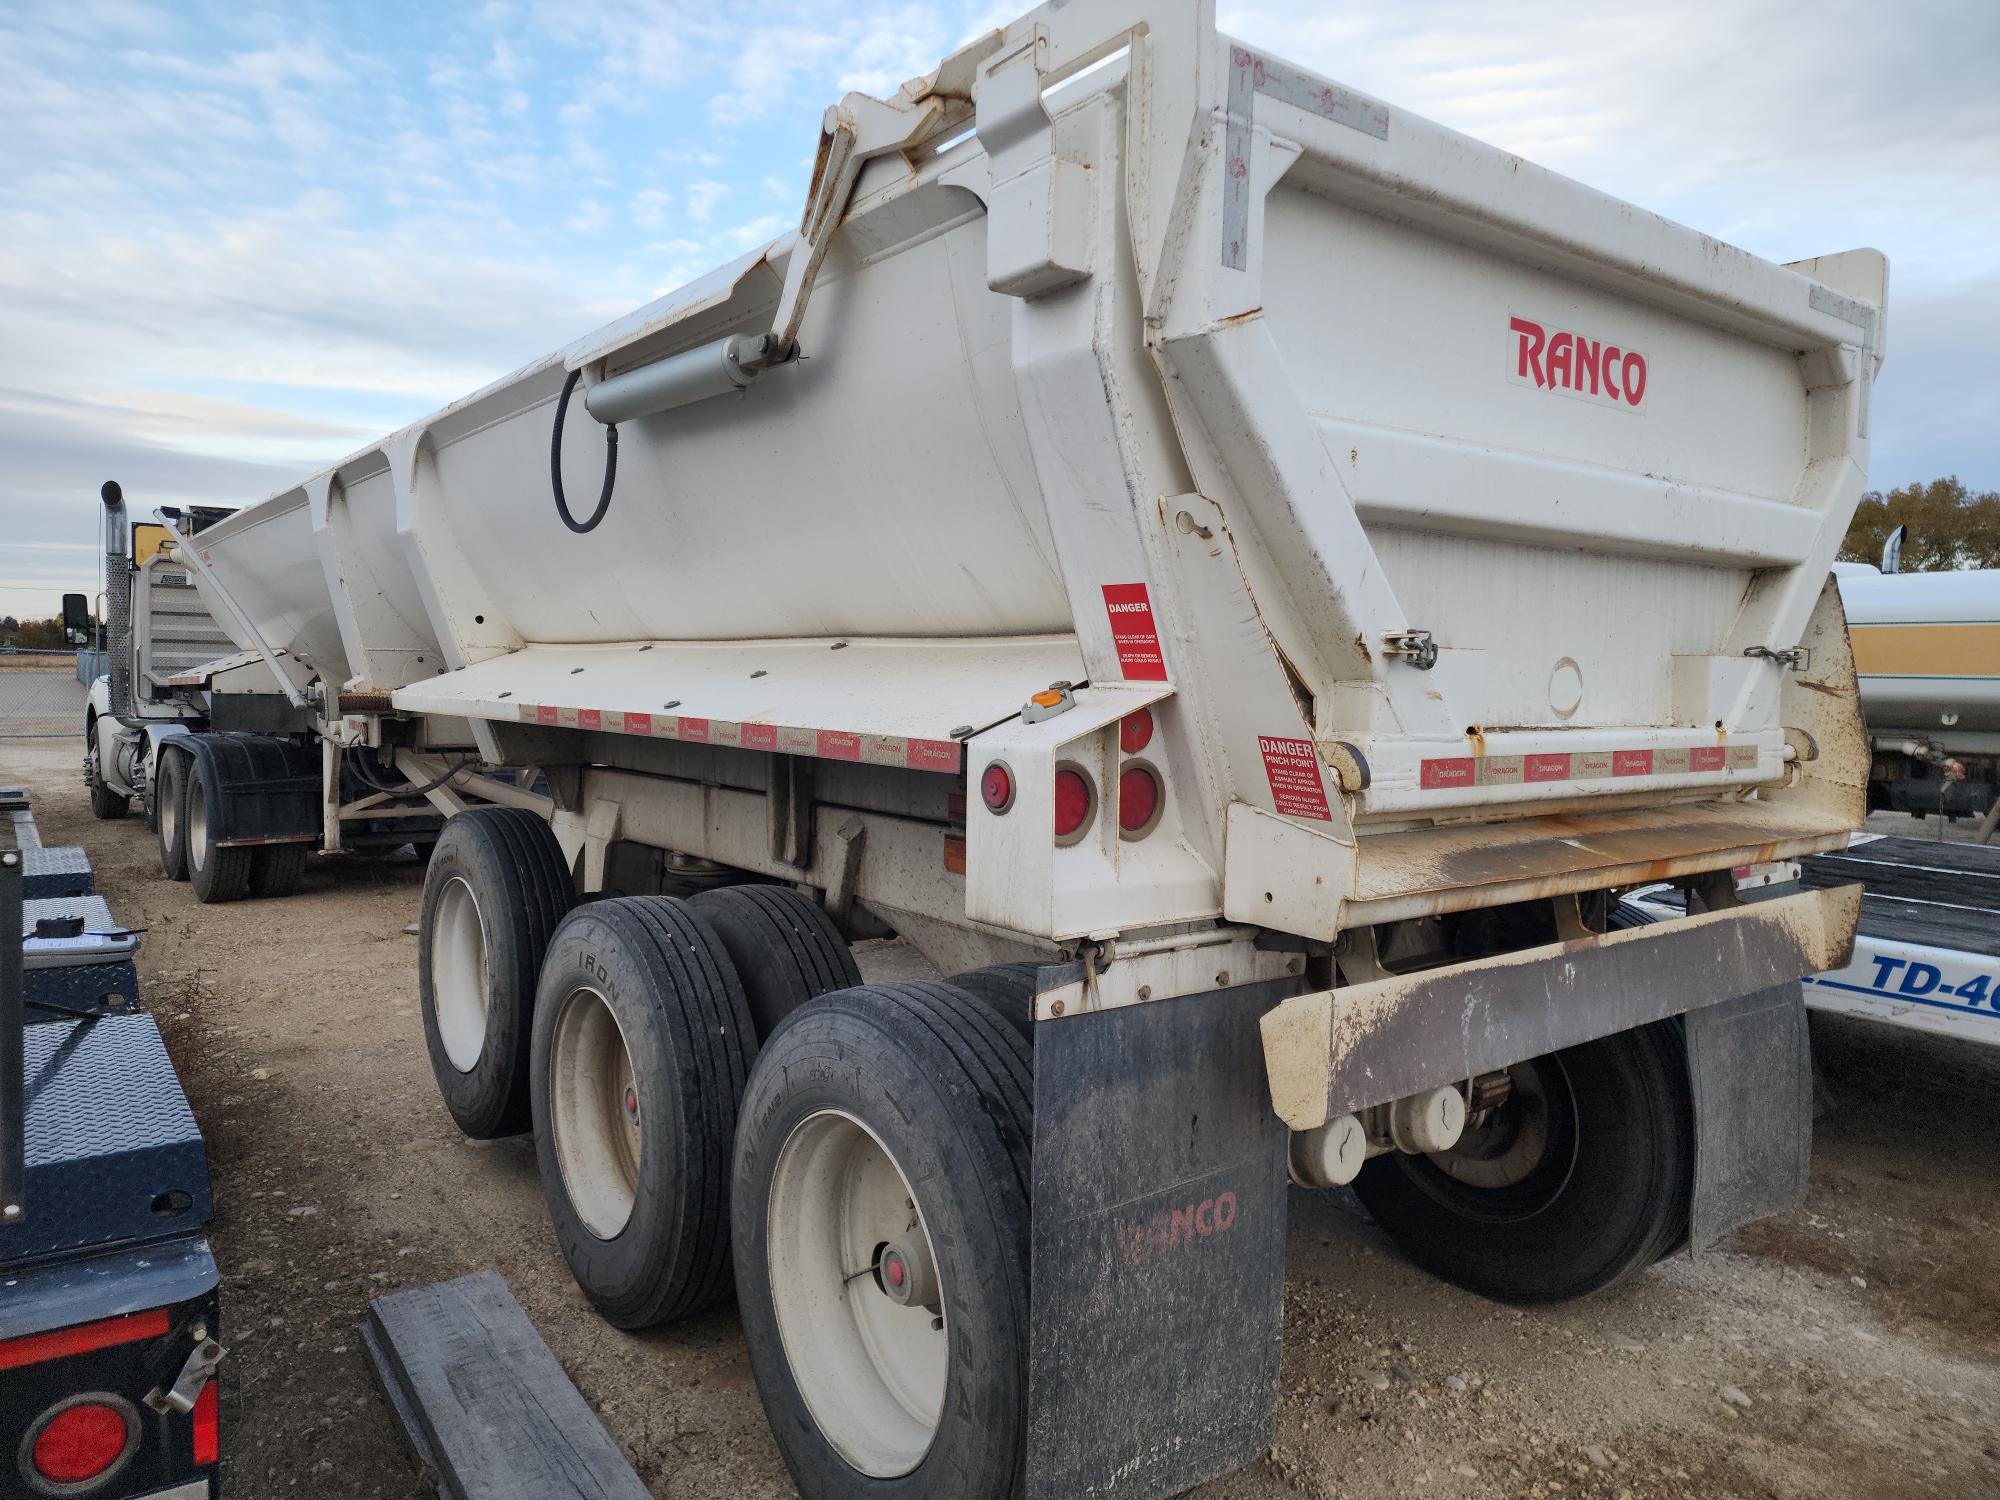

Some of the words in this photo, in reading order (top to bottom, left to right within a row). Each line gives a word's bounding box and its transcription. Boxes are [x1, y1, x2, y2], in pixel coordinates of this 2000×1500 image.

[1510, 316, 1647, 407] RANCO
[1109, 602, 1149, 613] DANGER
[830, 737, 854, 748] DRAGON
[876, 743, 901, 753] DRAGON
[923, 748, 952, 760] DRAGON
[1260, 739, 1314, 758] DANGER
[1265, 755, 1290, 765] PINCH
[1291, 758, 1314, 769] POINT
[1439, 769, 1467, 779] DRAGON
[1491, 766, 1518, 777] DRAGON
[1538, 764, 1564, 773] DRAGON
[1584, 760, 1608, 770] DRAGON
[1625, 760, 1647, 768] DRAGON
[1293, 785, 1322, 794] OPERATION
